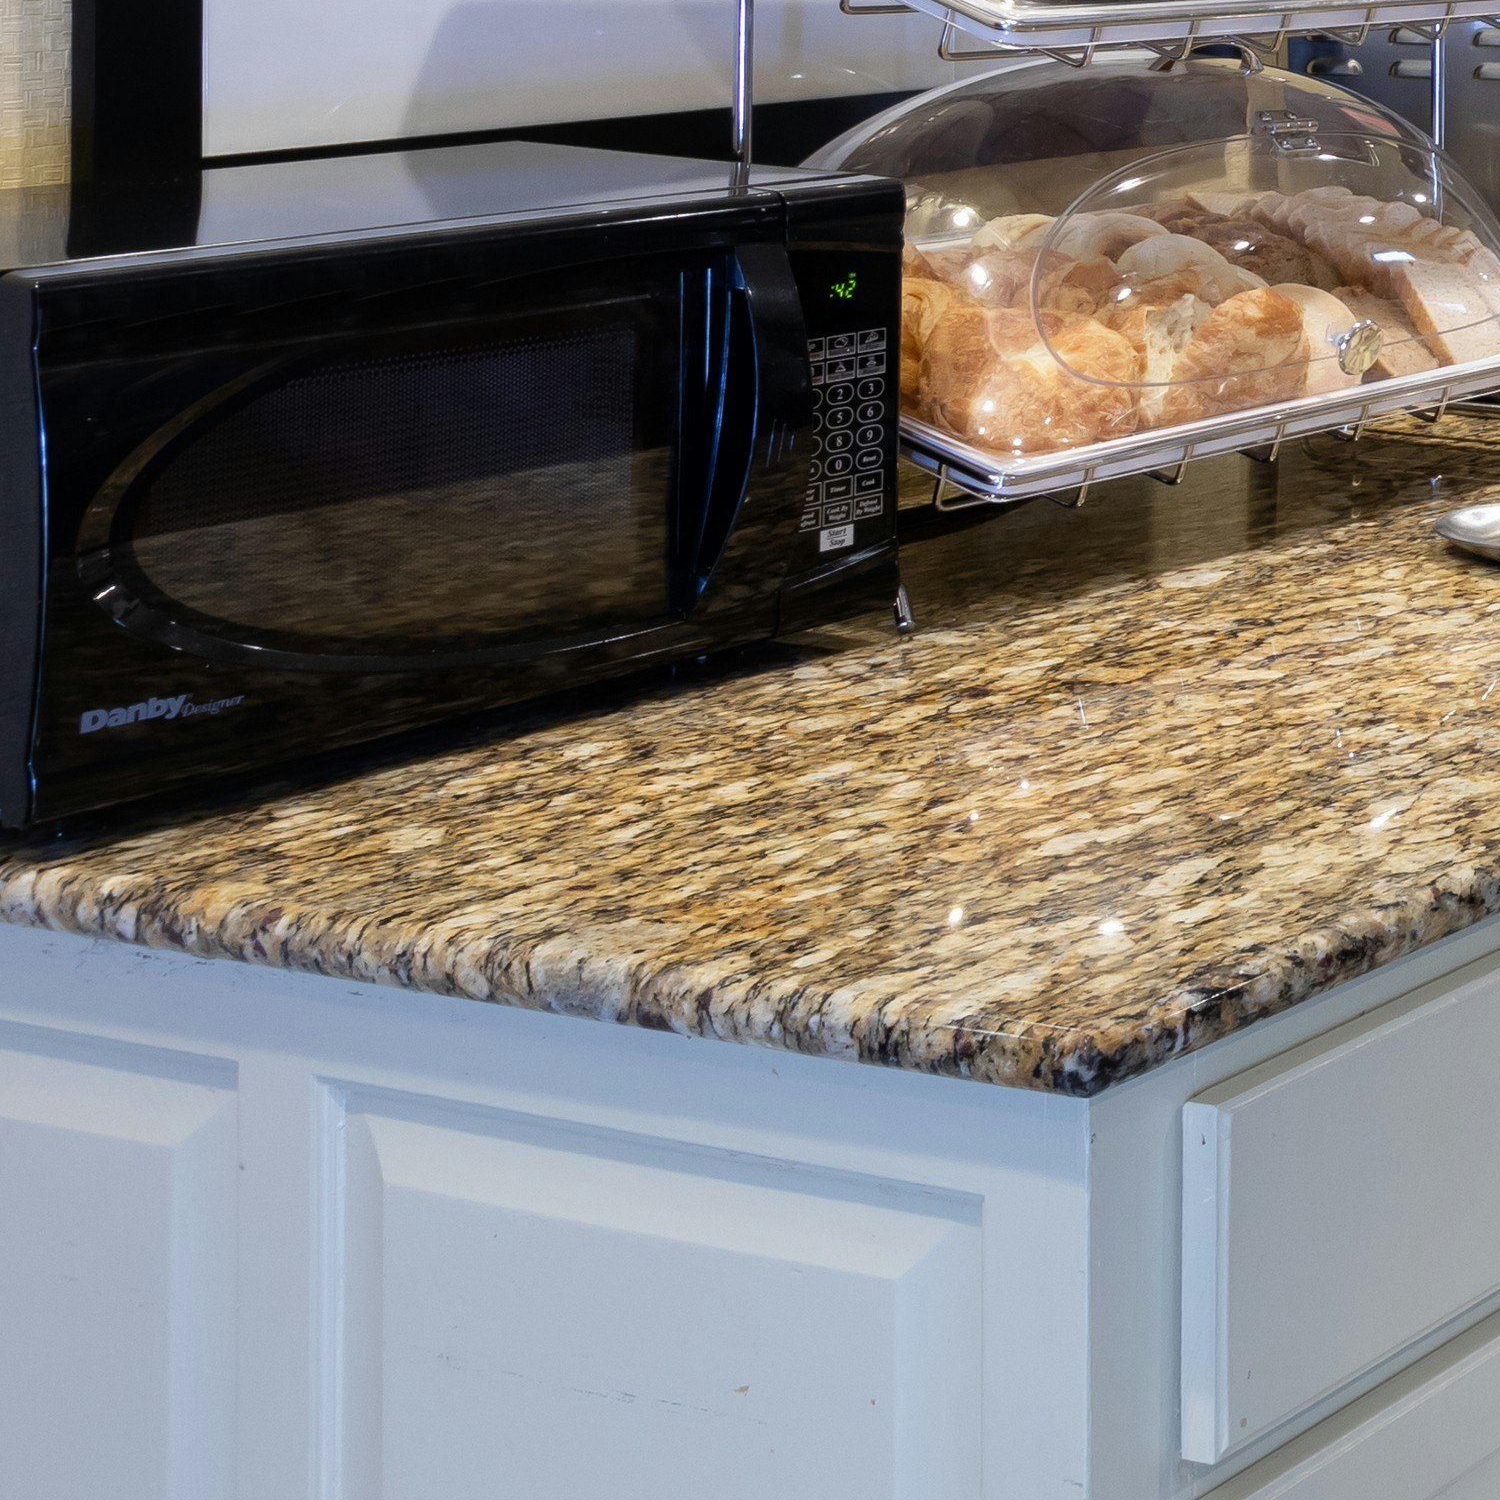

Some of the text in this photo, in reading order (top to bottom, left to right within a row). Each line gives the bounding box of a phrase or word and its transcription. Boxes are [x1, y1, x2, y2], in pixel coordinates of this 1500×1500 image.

[837, 383, 874, 400] 2 3
[837, 406, 874, 423] 5 6
[836, 430, 873, 447] 8 9
[835, 460, 843, 470] 0
[828, 528, 847, 537] Start
[79, 694, 245, 734] Danby Designer
